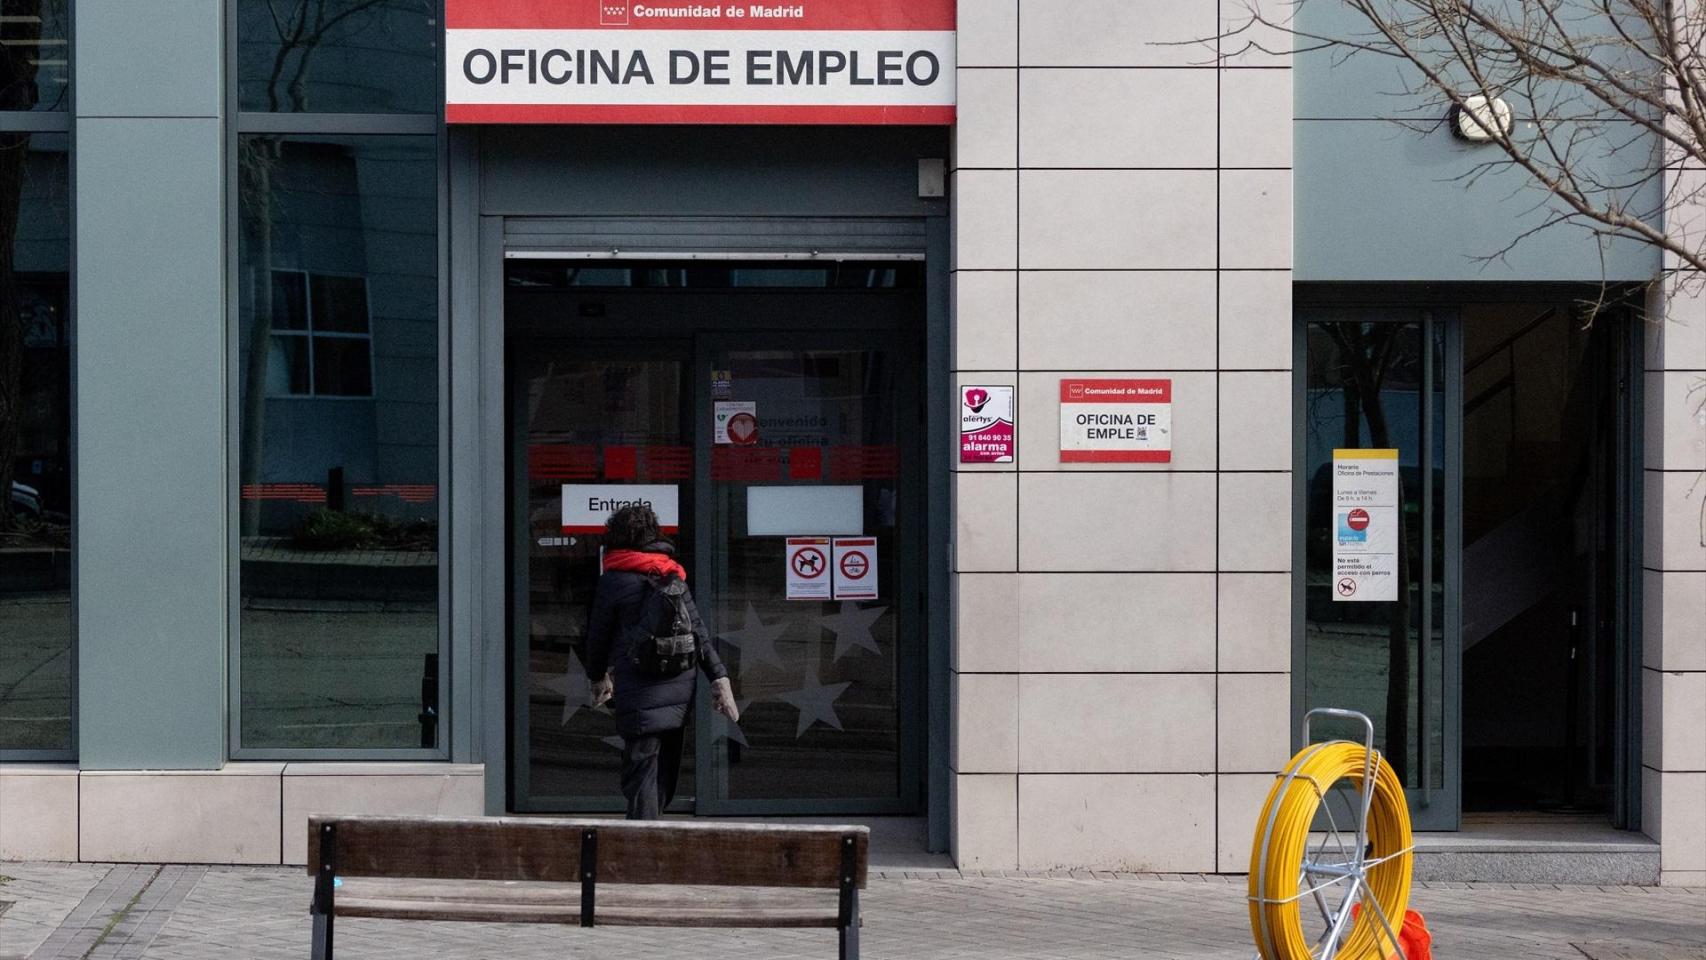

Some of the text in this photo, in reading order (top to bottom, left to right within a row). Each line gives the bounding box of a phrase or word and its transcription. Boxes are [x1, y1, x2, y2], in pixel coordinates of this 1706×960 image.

[633, 4, 804, 18] Comunidad de Madrid
[462, 48, 941, 87] OFICINA DE EMPLEO
[1084, 387, 1163, 395] Comunidad de Madrid
[1076, 414, 1156, 426] OFICINA DE
[963, 441, 1007, 452] alarma
